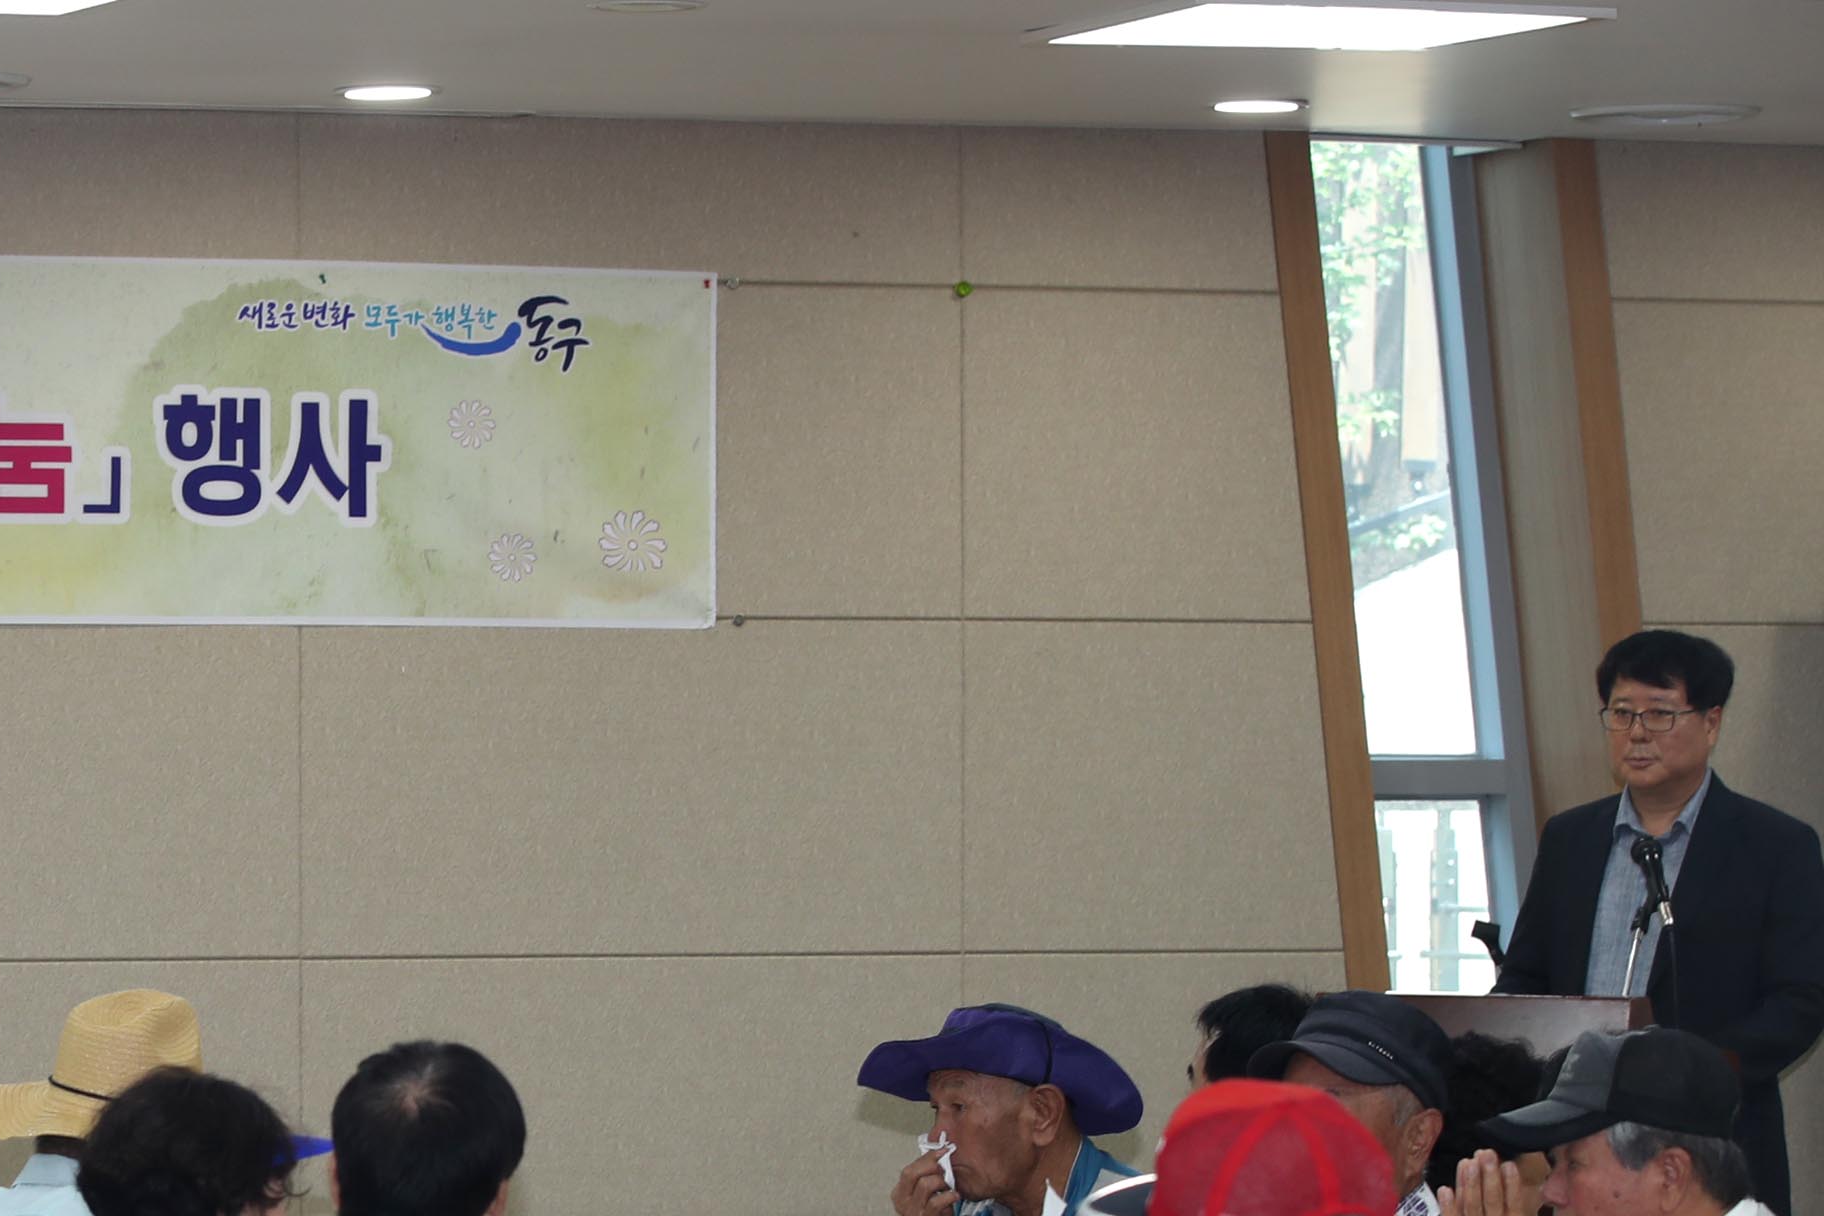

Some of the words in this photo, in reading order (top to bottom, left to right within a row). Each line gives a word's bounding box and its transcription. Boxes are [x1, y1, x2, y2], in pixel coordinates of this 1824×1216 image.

[364, 303, 425, 337] 모두가
[431, 303, 498, 340] 행복한
[517, 295, 590, 373] 동구
[162, 394, 382, 518] 행사
